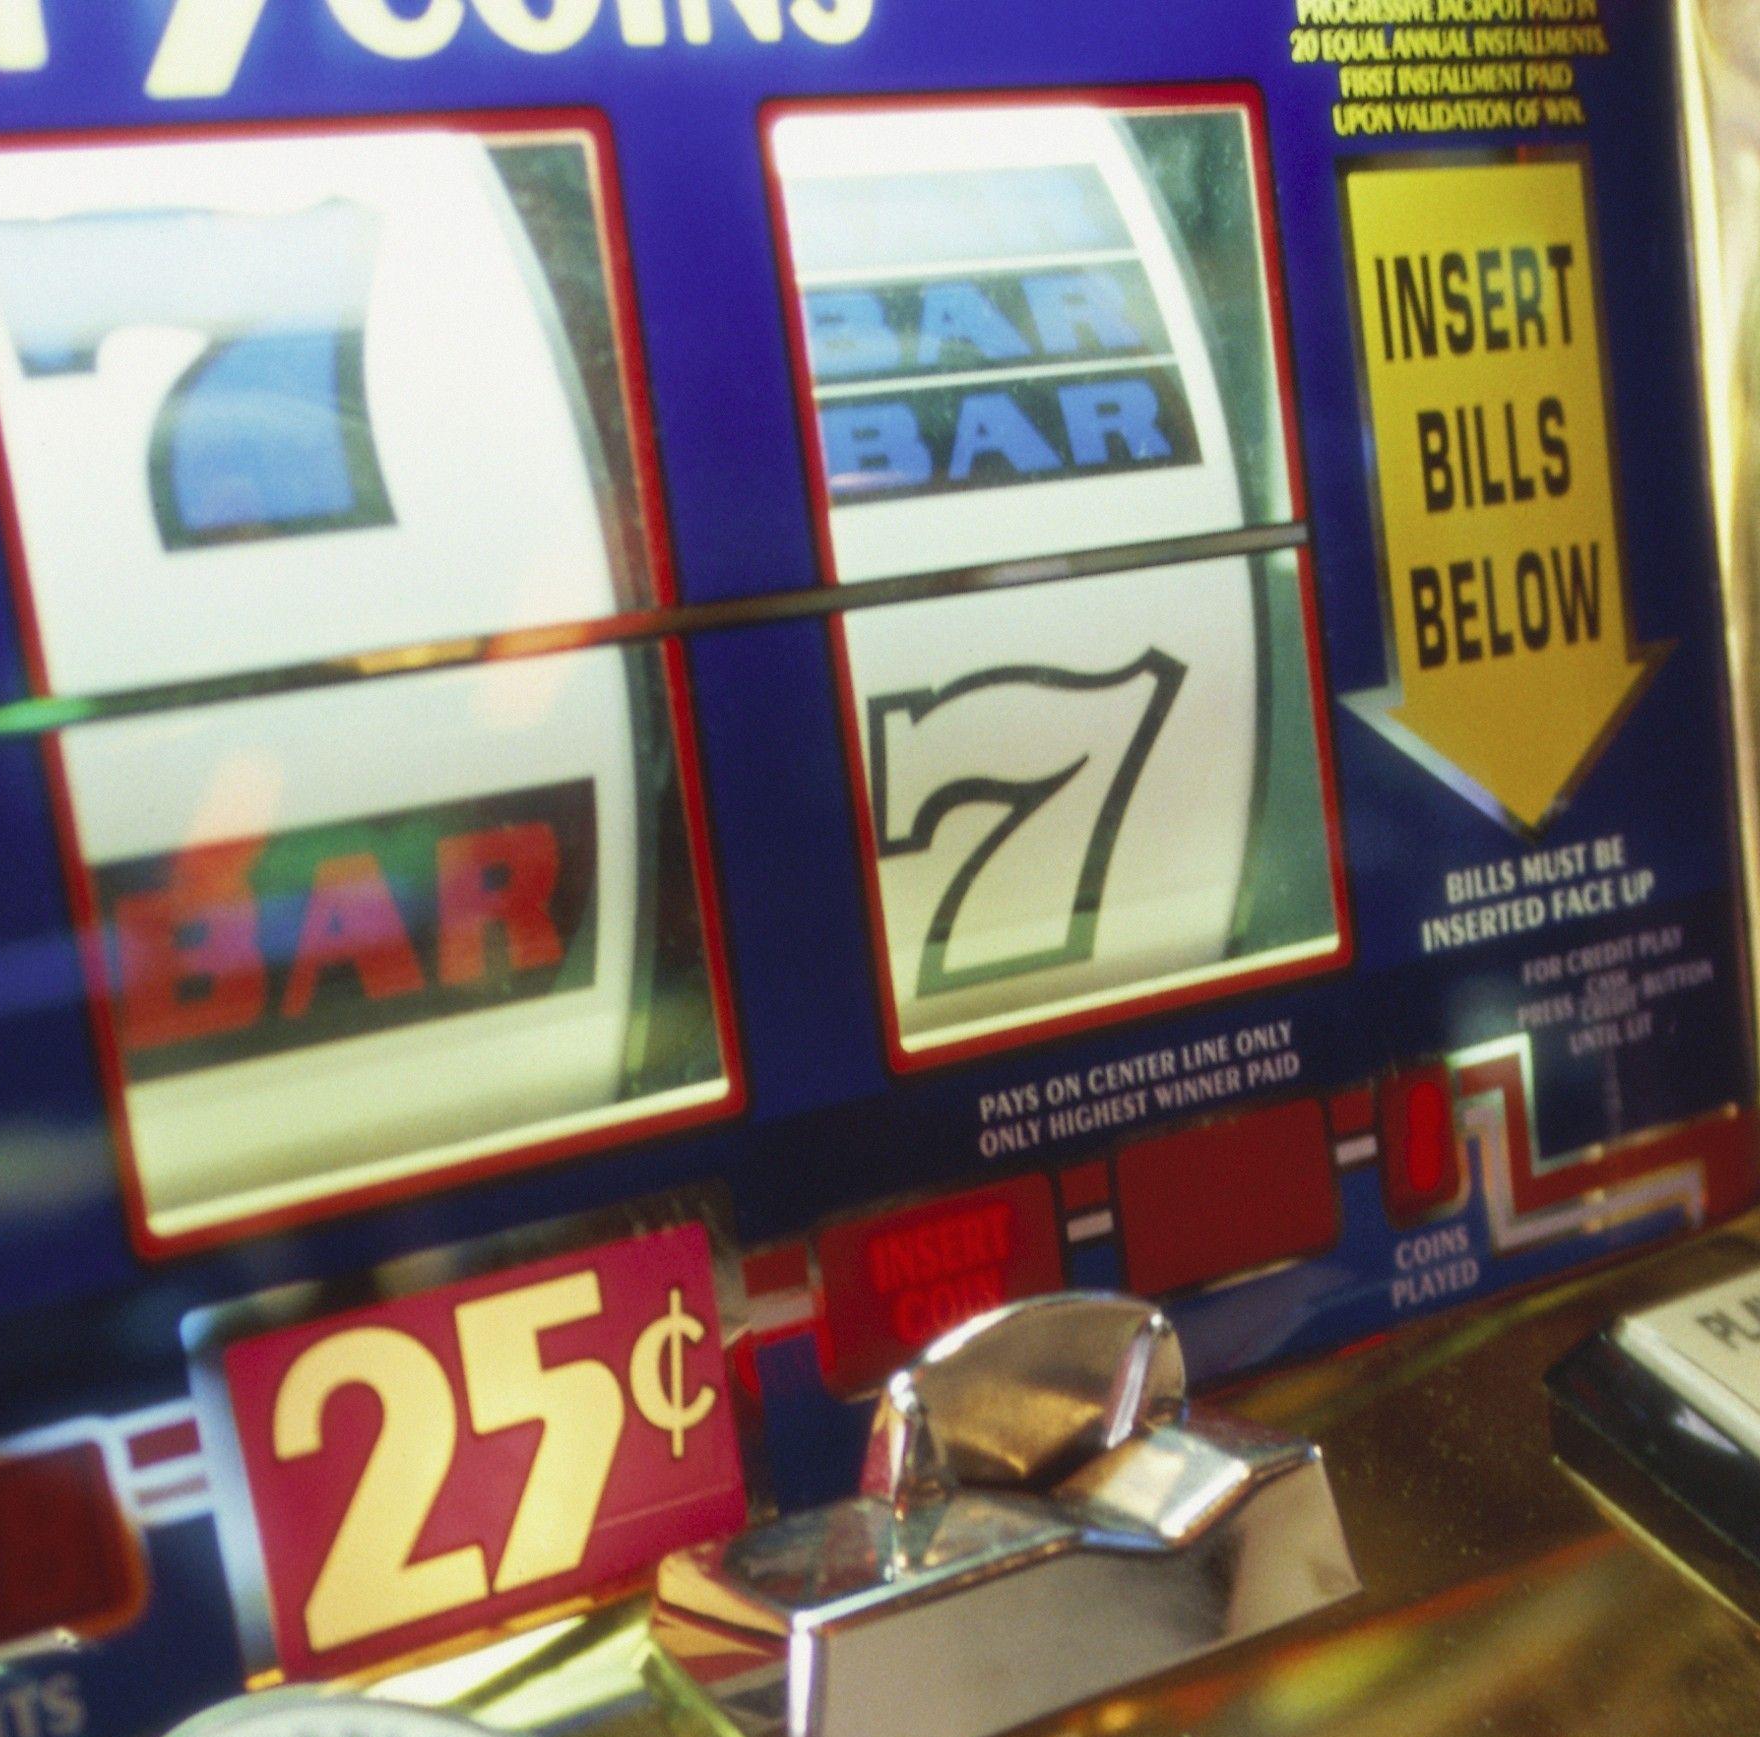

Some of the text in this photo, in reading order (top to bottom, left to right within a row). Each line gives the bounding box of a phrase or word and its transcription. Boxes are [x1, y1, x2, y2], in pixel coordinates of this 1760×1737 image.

[1290, 28, 1320, 63] 20
[1321, 27, 1392, 63] EQUAL
[1392, 26, 1473, 60] ANNUAL
[1340, 60, 1574, 98] FIRST INSTALLMENT PAID
[1333, 102, 1394, 136] UPON
[1393, 98, 1513, 133] VALIDATION
[1514, 97, 1541, 128] OF
[802, 268, 1145, 378] BAR
[1375, 241, 1574, 362] INSERT
[819, 377, 1174, 494] BAR
[1416, 394, 1572, 514] BILLS
[1409, 541, 1601, 671] BELOW
[866, 645, 1189, 1001] 7
[1445, 834, 1626, 905] BILLS MUST BE
[118, 820, 566, 1050] BAR
[1421, 867, 1656, 953] INSERTED FACE UP
[978, 1051, 1301, 1158] ONLY HIGHEST WINNER PAID
[979, 1020, 1293, 1123] PAYS ON CENTER LINE ONLY
[867, 1201, 1011, 1294] INSERT
[1389, 1258, 1480, 1310] PLAYED
[1394, 1224, 1471, 1272] COINS
[272, 1268, 717, 1656] 25¢
